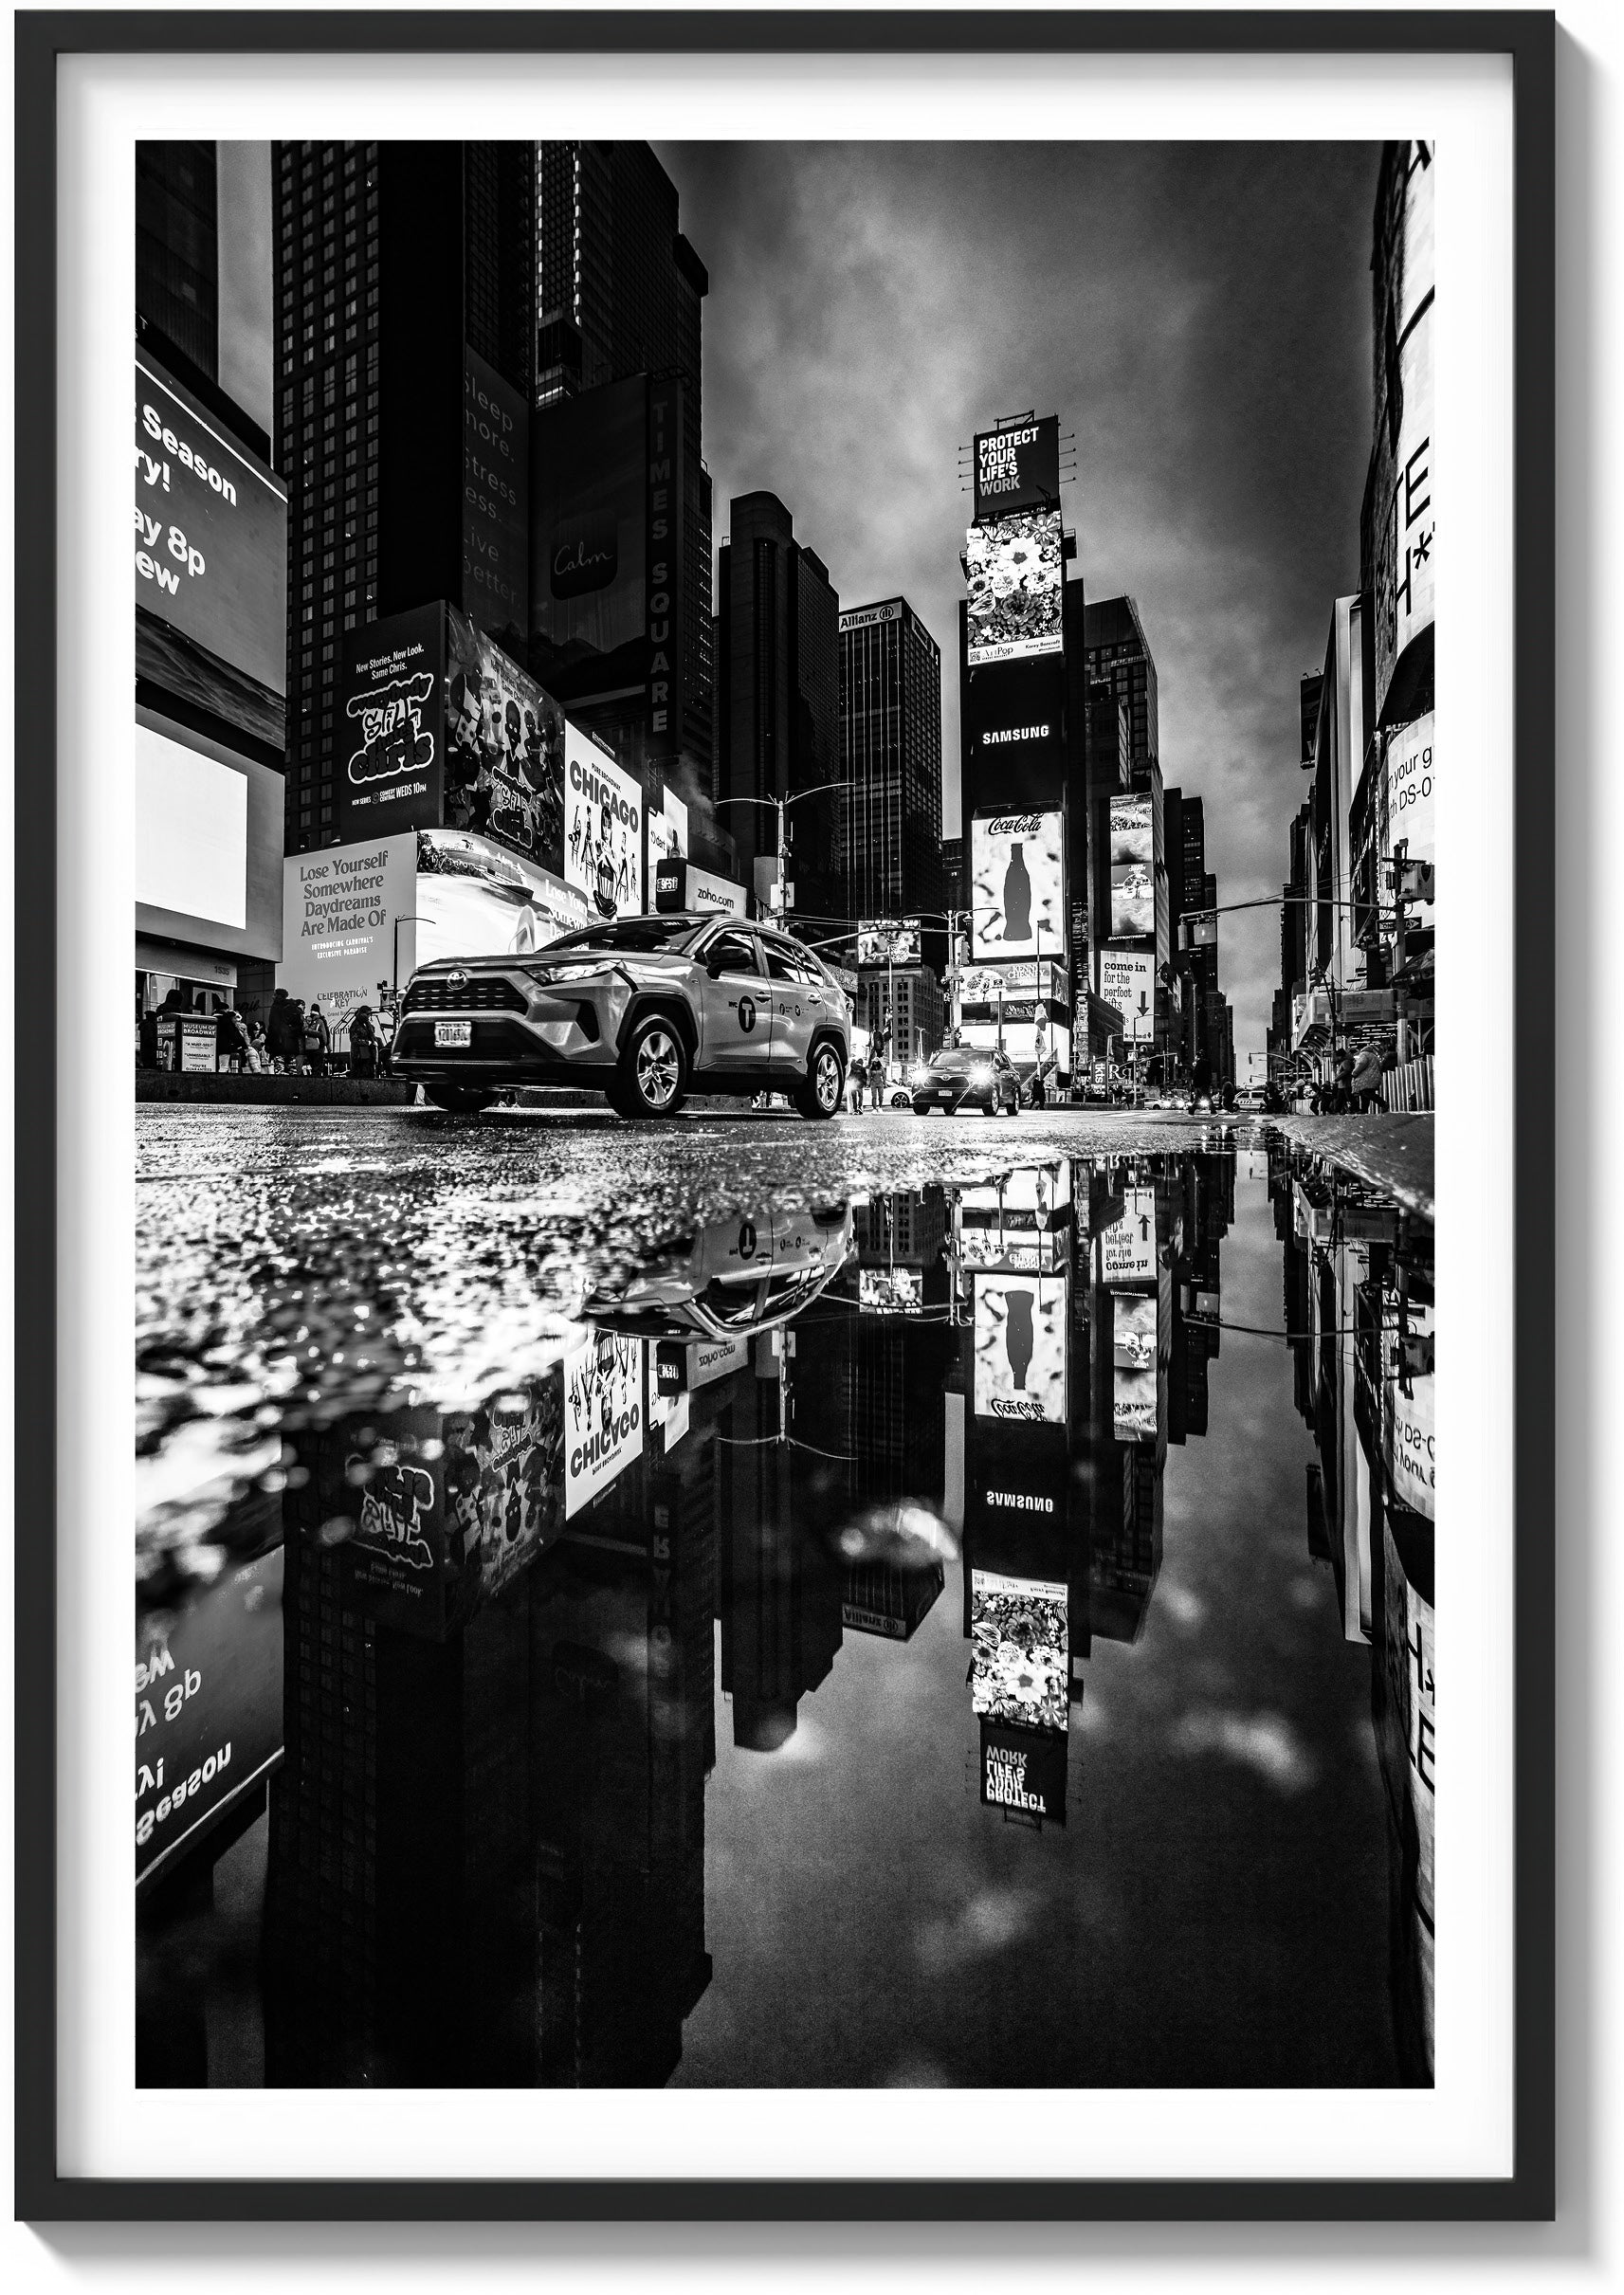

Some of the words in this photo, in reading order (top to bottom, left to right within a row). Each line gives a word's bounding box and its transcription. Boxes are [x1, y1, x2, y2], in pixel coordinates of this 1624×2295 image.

[979, 427, 1039, 454] PROTECT
[142, 404, 237, 507] Season
[979, 447, 1016, 469] YOUR
[648, 400, 671, 541] TIMES
[979, 461, 1018, 483] LIFE'S
[979, 475, 1021, 497] WORK
[465, 486, 502, 522] ess.
[168, 525, 206, 576] 8p
[464, 525, 498, 562] ive
[553, 541, 614, 577] Calm
[840, 611, 878, 629] Allianz
[648, 561, 671, 733] SQUARE
[356, 663, 369, 674] New
[369, 655, 392, 671] Stories.
[392, 649, 407, 662] New
[407, 644, 424, 657] Look.
[371, 667, 389, 681] Same
[389, 662, 408, 675] Chris.
[982, 724, 1049, 745] SAMSUNG
[592, 763, 601, 776] PURE
[396, 786, 412, 799] WEDS
[570, 760, 639, 833] CHICAGO
[988, 811, 1044, 835] Coca-Cola
[300, 865, 329, 882] Lose
[332, 850, 389, 876] Yourself
[303, 875, 384, 900] Somewhere
[697, 887, 735, 909] zoho.com
[305, 895, 381, 919] Daydreams
[301, 920, 324, 937] Are
[327, 914, 365, 934] Made
[368, 909, 387, 927] Of
[312, 939, 344, 951] INTRODUCING
[345, 937, 374, 947] CARNIVAL'S
[317, 949, 342, 959] EXCLUSIVE
[343, 947, 368, 956] PARADISE
[1104, 962, 1134, 972] come
[1135, 961, 1147, 973] in
[1104, 971, 1116, 984] for
[1117, 971, 1130, 984] the
[317, 988, 368, 1001] CELEBRATION
[335, 998, 350, 1009] KEY
[1104, 988, 1133, 1000] perfect
[1095, 1063, 1105, 1084] tkts
